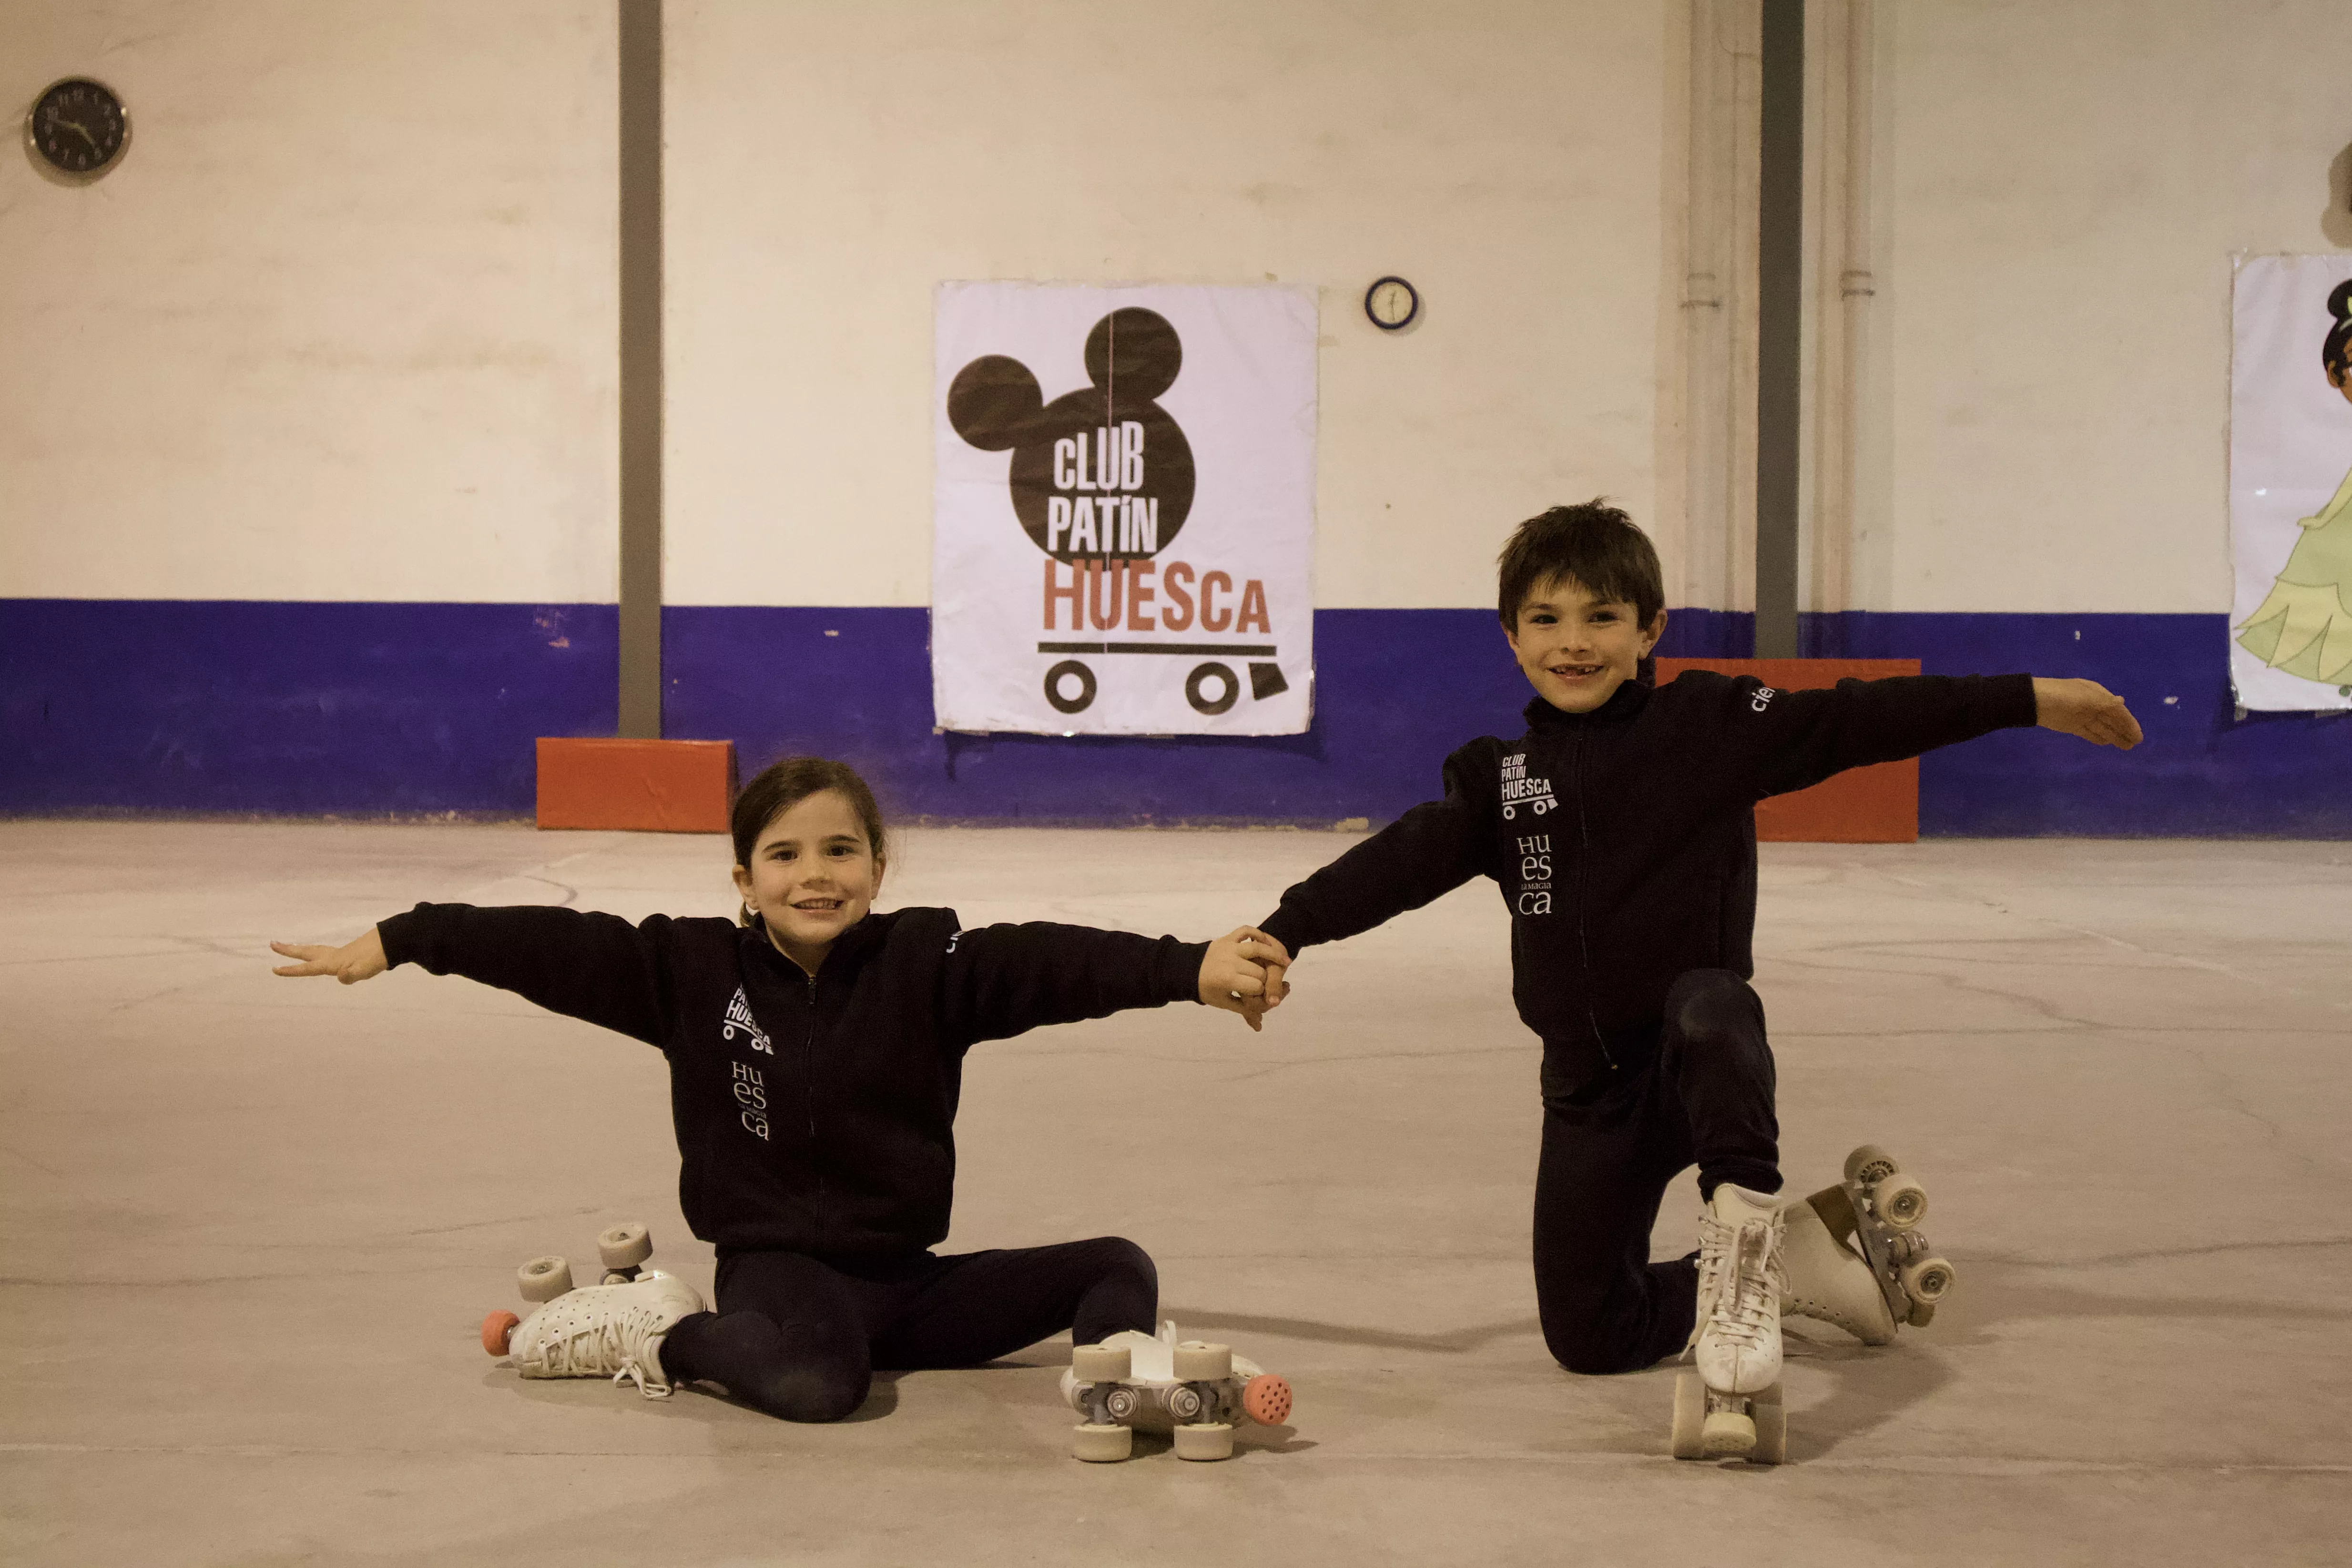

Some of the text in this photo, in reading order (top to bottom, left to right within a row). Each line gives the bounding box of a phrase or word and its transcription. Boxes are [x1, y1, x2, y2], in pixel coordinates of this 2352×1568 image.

[1054, 421, 1144, 490] CLUB
[1048, 494, 1159, 553] PATÍN
[1043, 559, 1272, 633] HUESCA
[1502, 753, 1526, 767] CLUB
[1502, 778, 1552, 801] HUESCA
[1522, 855, 1552, 881] es
[1518, 891, 1552, 916] ca
[733, 1082, 766, 1110] es
[742, 1111, 769, 1141] ca
